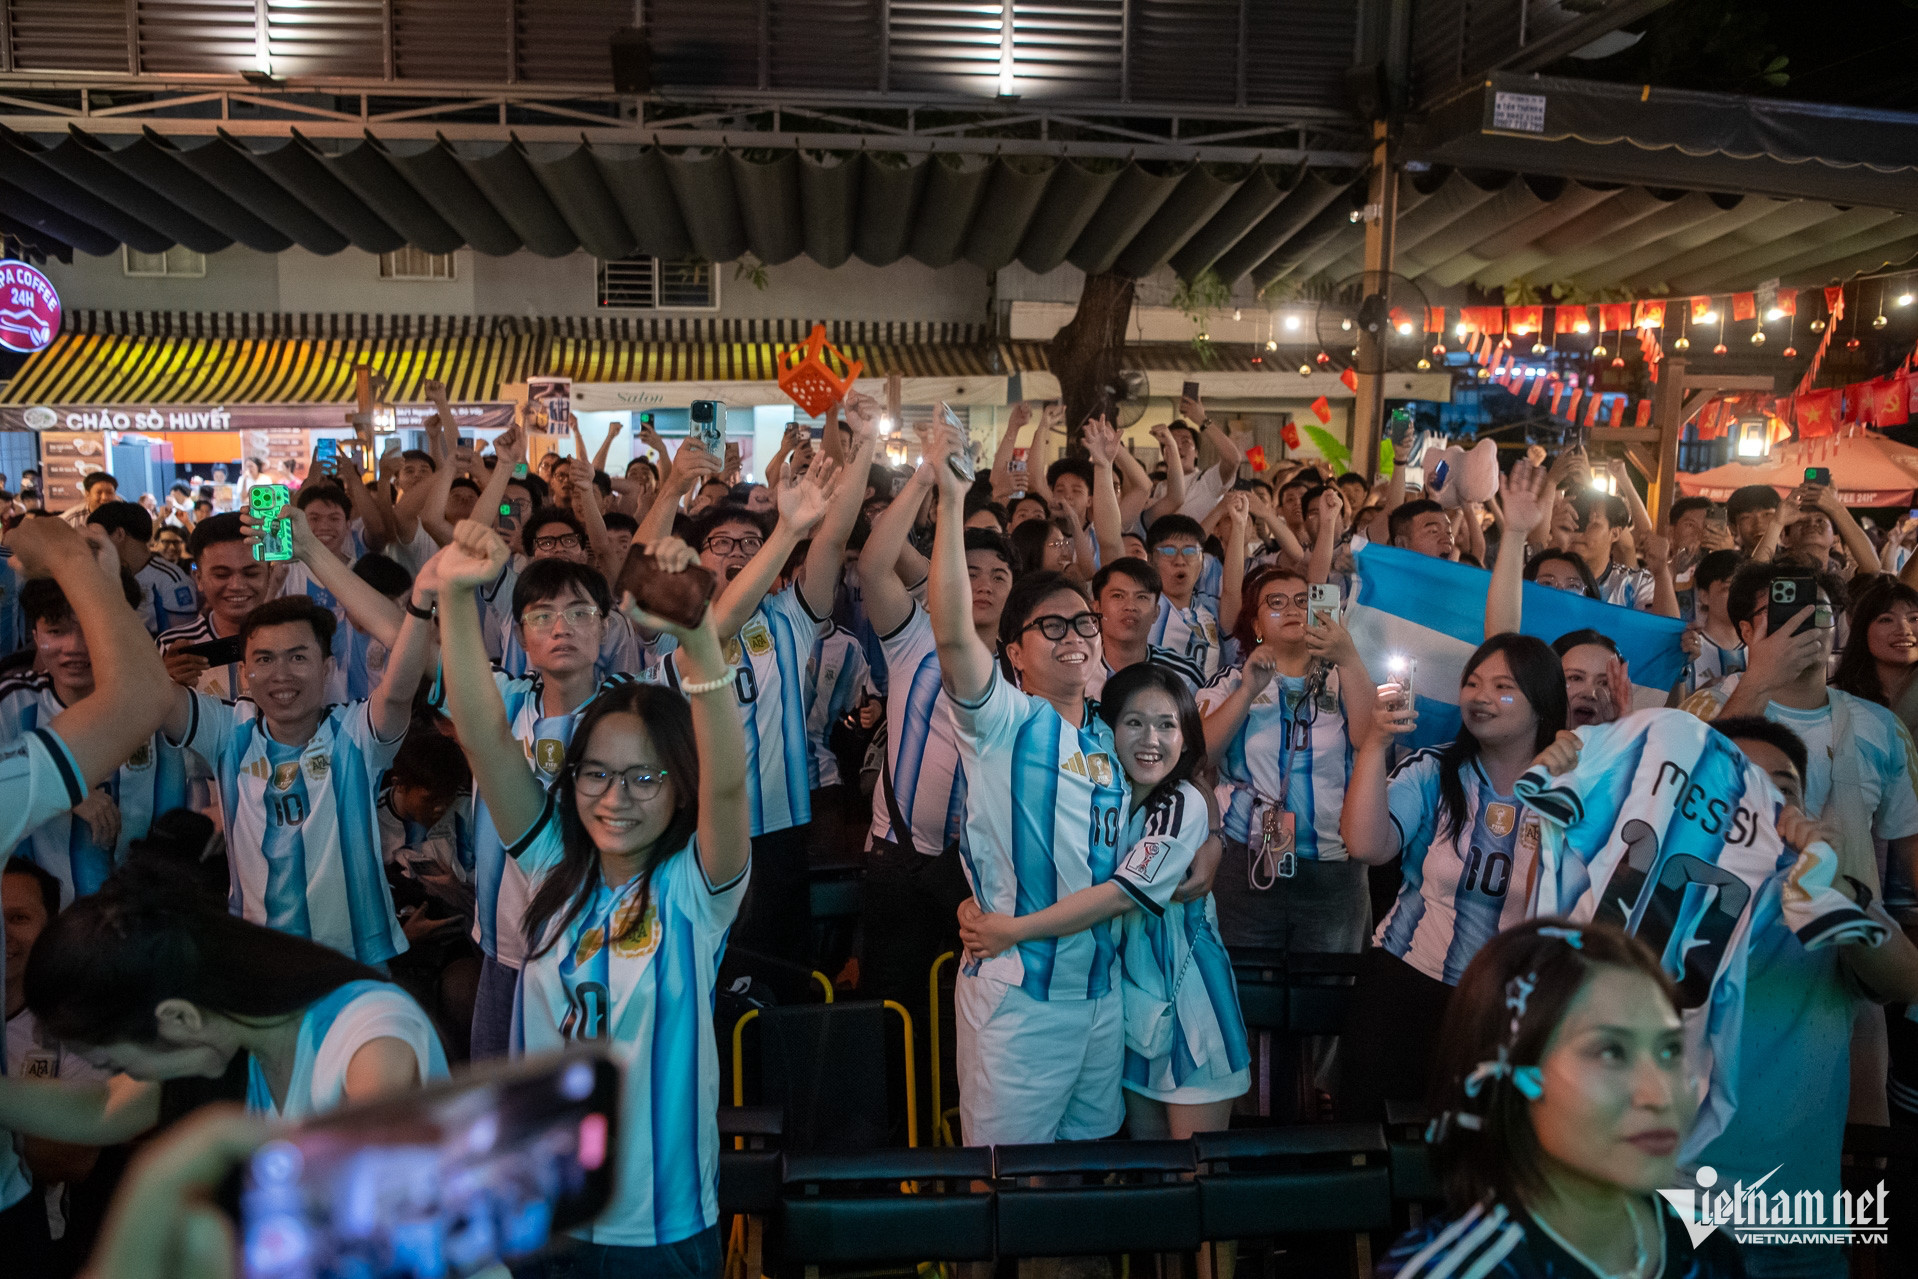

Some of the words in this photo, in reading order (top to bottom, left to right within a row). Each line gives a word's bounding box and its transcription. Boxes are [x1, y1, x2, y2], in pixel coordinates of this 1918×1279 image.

[10, 287, 34, 308] 24H
[16, 268, 58, 312] COFFEE
[617, 391, 663, 404] Salon
[65, 408, 131, 431] CHÁO
[134, 408, 165, 431] SÒ
[168, 405, 231, 431] HUYẾT
[273, 793, 305, 827] 10
[1651, 760, 1759, 848] MESSI
[1093, 805, 1119, 848] 10
[1464, 845, 1513, 898] 10
[28, 1059, 49, 1078] AFA
